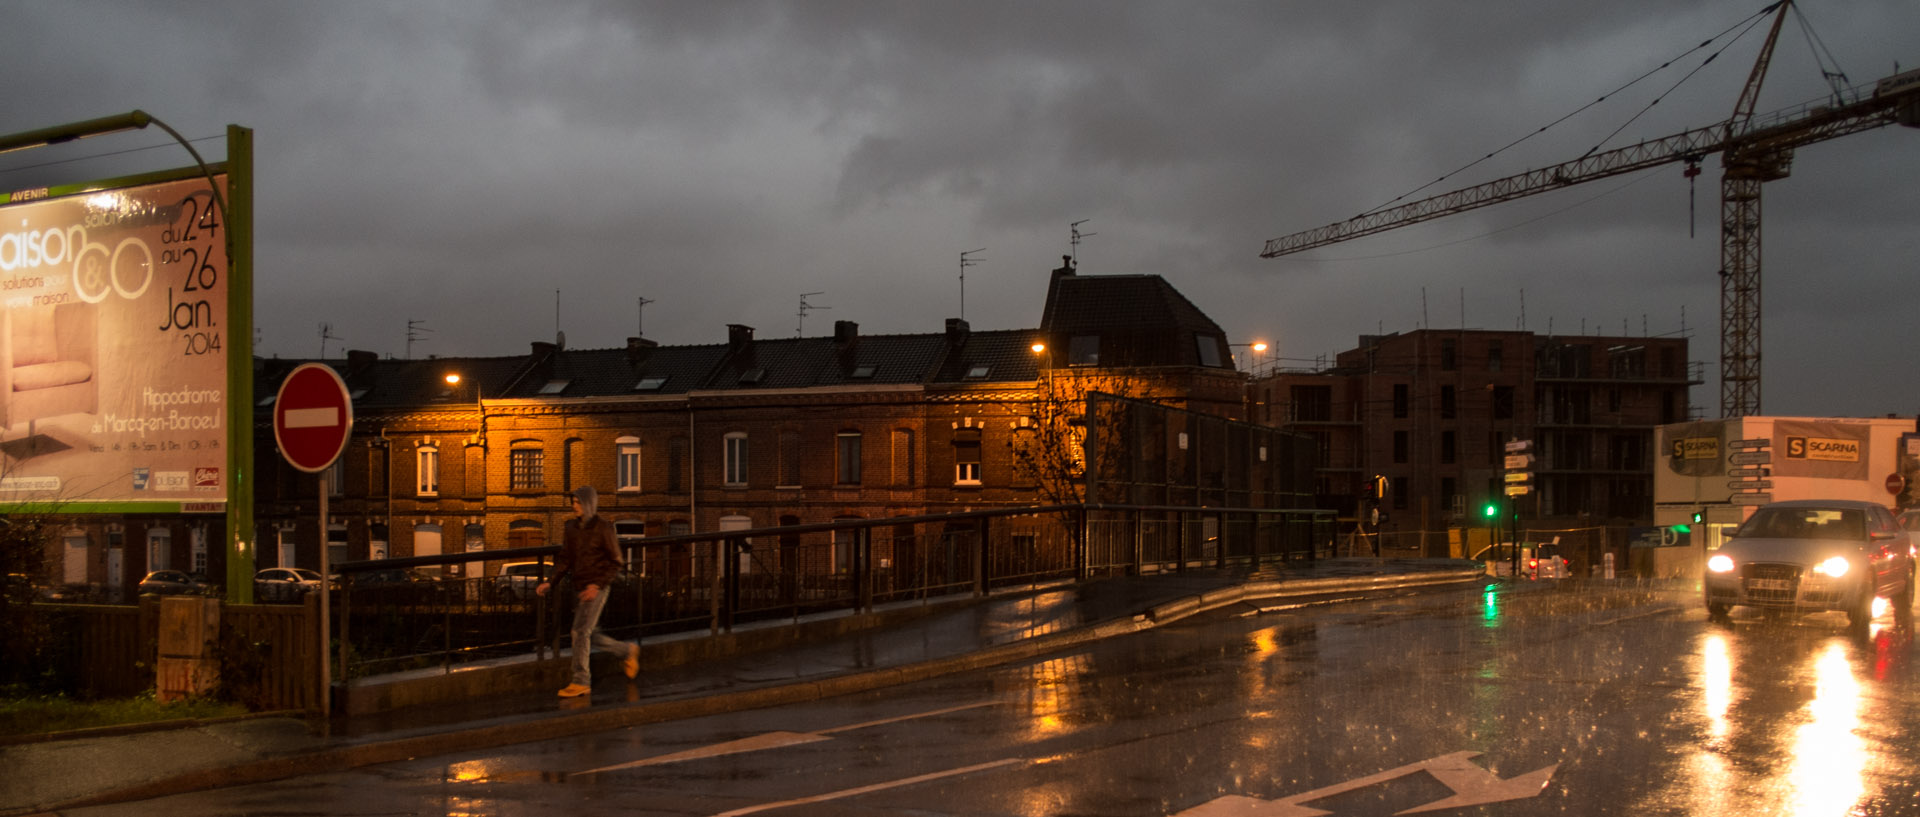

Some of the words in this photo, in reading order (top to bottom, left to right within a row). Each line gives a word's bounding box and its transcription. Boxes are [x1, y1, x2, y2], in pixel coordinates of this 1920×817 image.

[11, 188, 49, 202] AVENIR
[161, 221, 181, 244] du
[183, 194, 219, 241] 24
[161, 249, 181, 264] au
[183, 245, 217, 292] 26
[3, 273, 44, 290] solutions
[33, 292, 70, 305] maison
[159, 287, 217, 331] Jan.
[184, 332, 222, 355] 2014
[143, 384, 220, 412] Hippodrome
[1674, 441, 1683, 457] S
[1790, 440, 1804, 455] S
[1809, 441, 1858, 454] SCARNA
